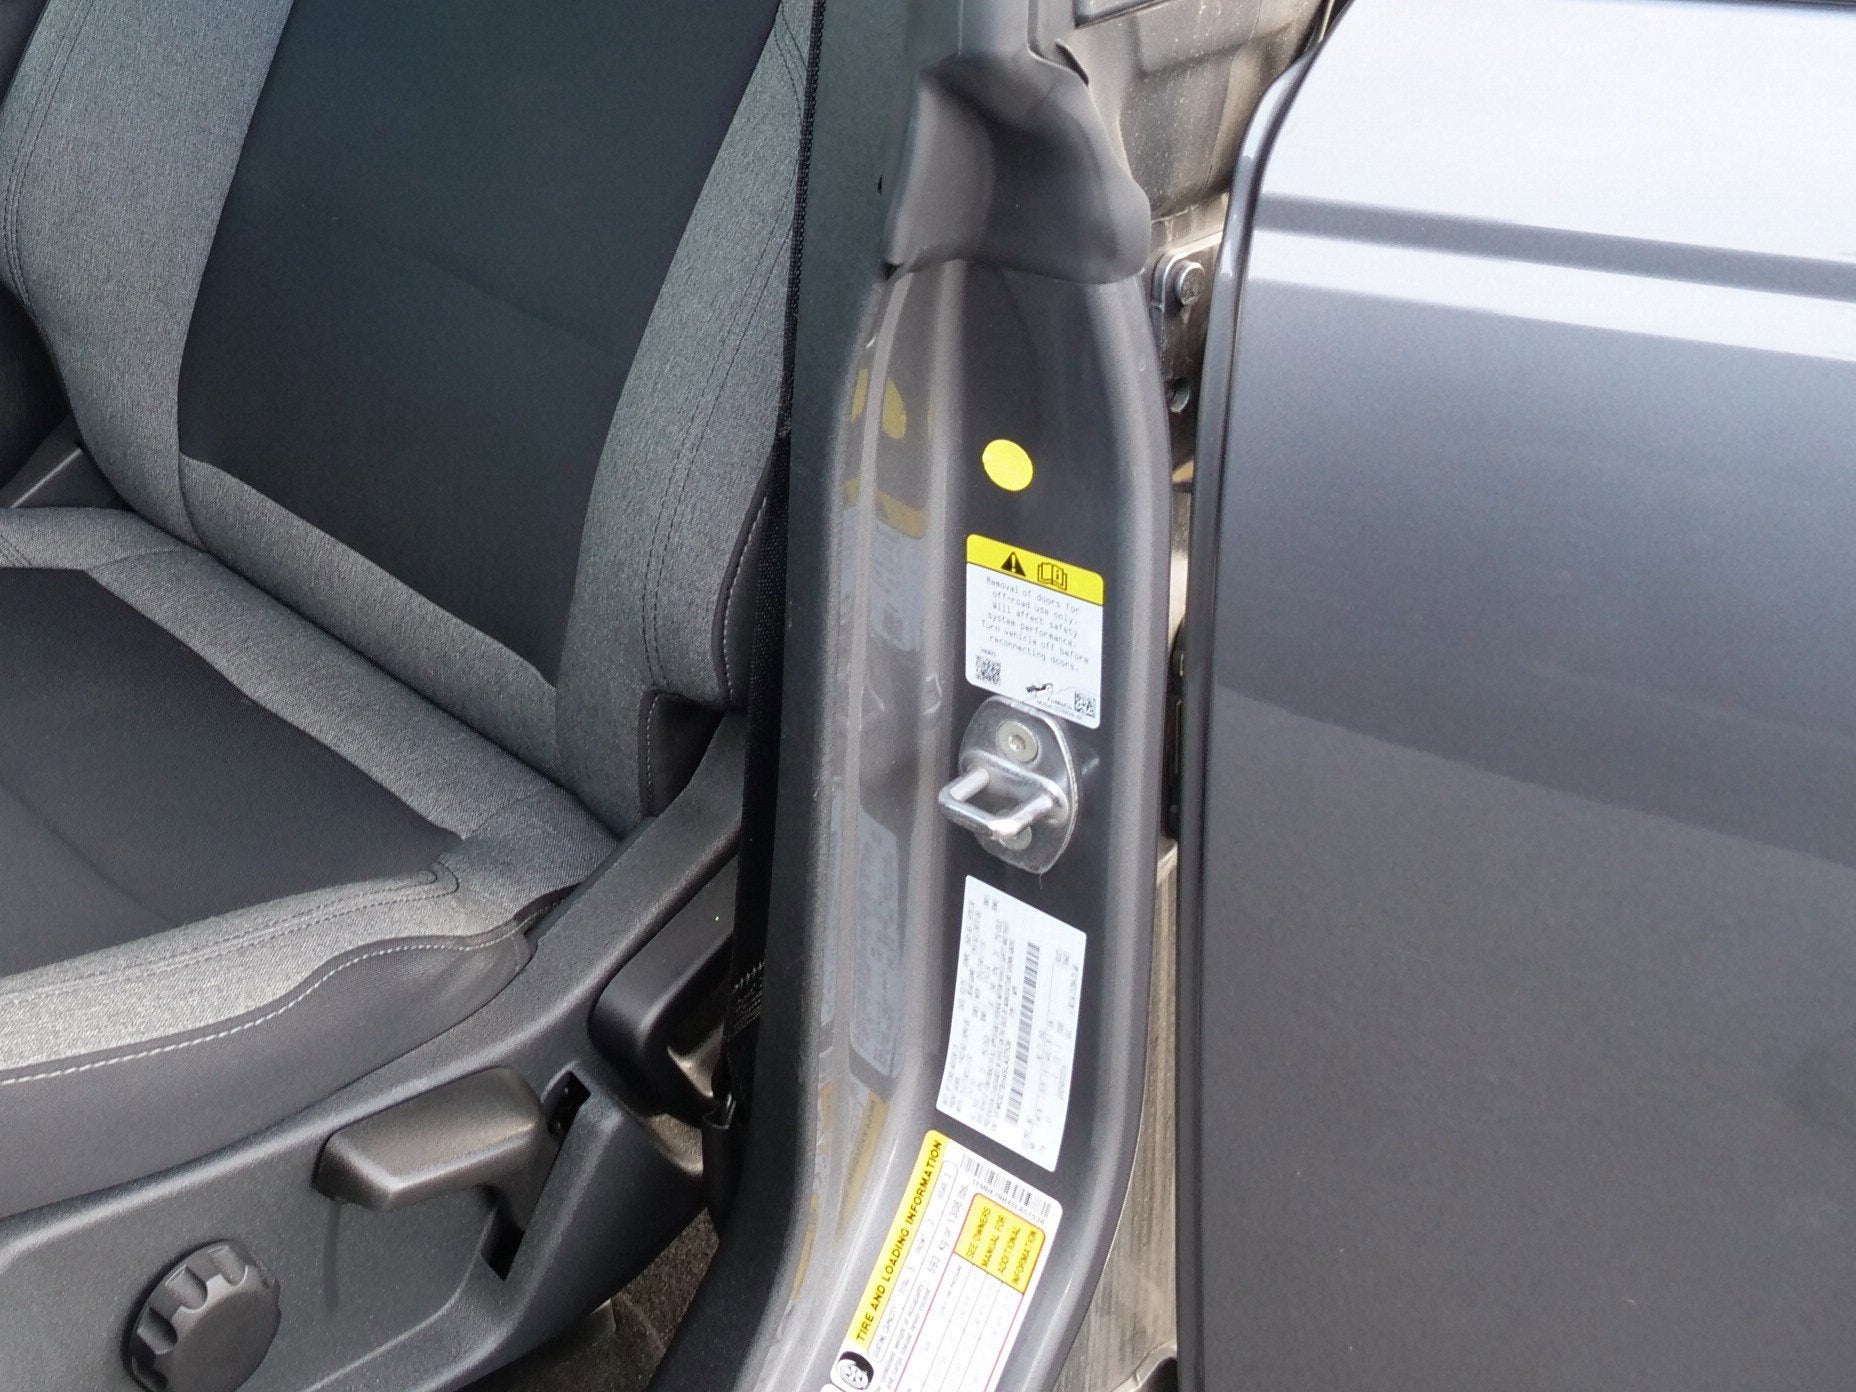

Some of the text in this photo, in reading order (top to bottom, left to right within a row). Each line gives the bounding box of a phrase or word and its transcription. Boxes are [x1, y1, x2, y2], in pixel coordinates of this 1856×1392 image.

[1036, 592, 1061, 608] doors
[1065, 602, 1080, 615] for
[854, 1137, 945, 1342] TIRE AND LOADING INFORMATION
[964, 1242, 978, 1259] SEE
[971, 1205, 992, 1242] OWNERS
[980, 1213, 1007, 1268] MANUAL FOR
[995, 1225, 1021, 1274] ADDITIONAL
[1010, 1229, 1039, 1285] INFORMATION
